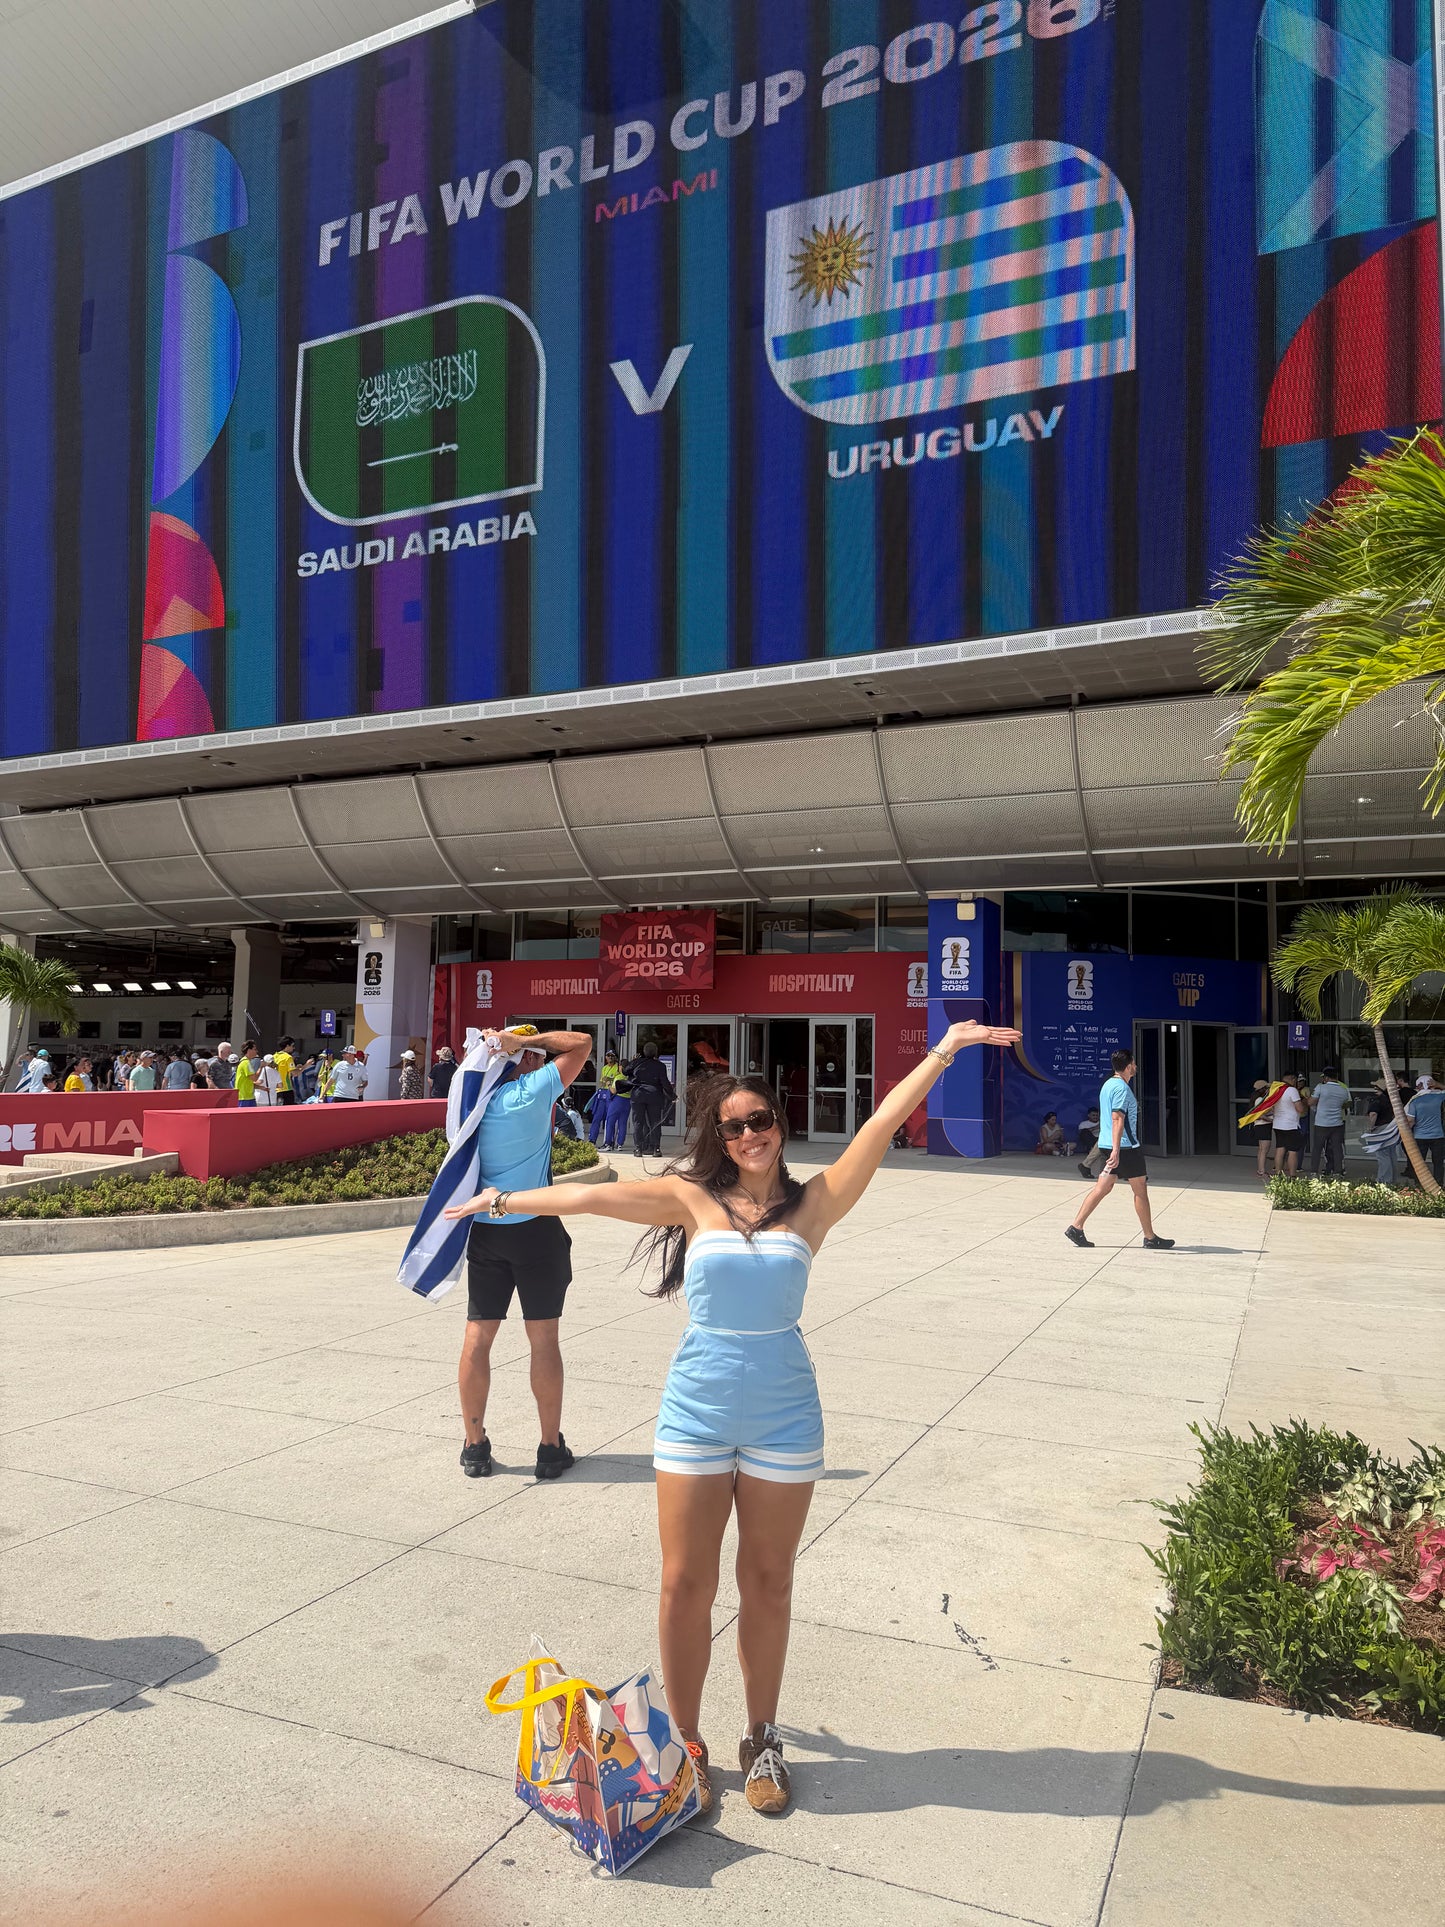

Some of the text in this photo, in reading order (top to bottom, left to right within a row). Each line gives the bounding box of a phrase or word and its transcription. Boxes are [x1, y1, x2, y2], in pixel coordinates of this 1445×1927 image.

[319, 0, 1101, 267] FIFA WORLD CUP 2026
[595, 169, 718, 223] MIAMI
[609, 343, 694, 415] V
[827, 405, 1065, 479] URUGUAY
[297, 510, 538, 577] SAUDI ARABIA
[637, 925, 674, 940] FIFA
[761, 920, 797, 932] GATE
[607, 941, 706, 960] WORLD CUP
[624, 961, 684, 977] 2026
[768, 974, 855, 992] HOSPITALITY
[1172, 972, 1205, 987] GATE S
[667, 994, 700, 1008] GATE S
[1177, 988, 1200, 1007] VIP
[897, 1046, 915, 1054] 245A
